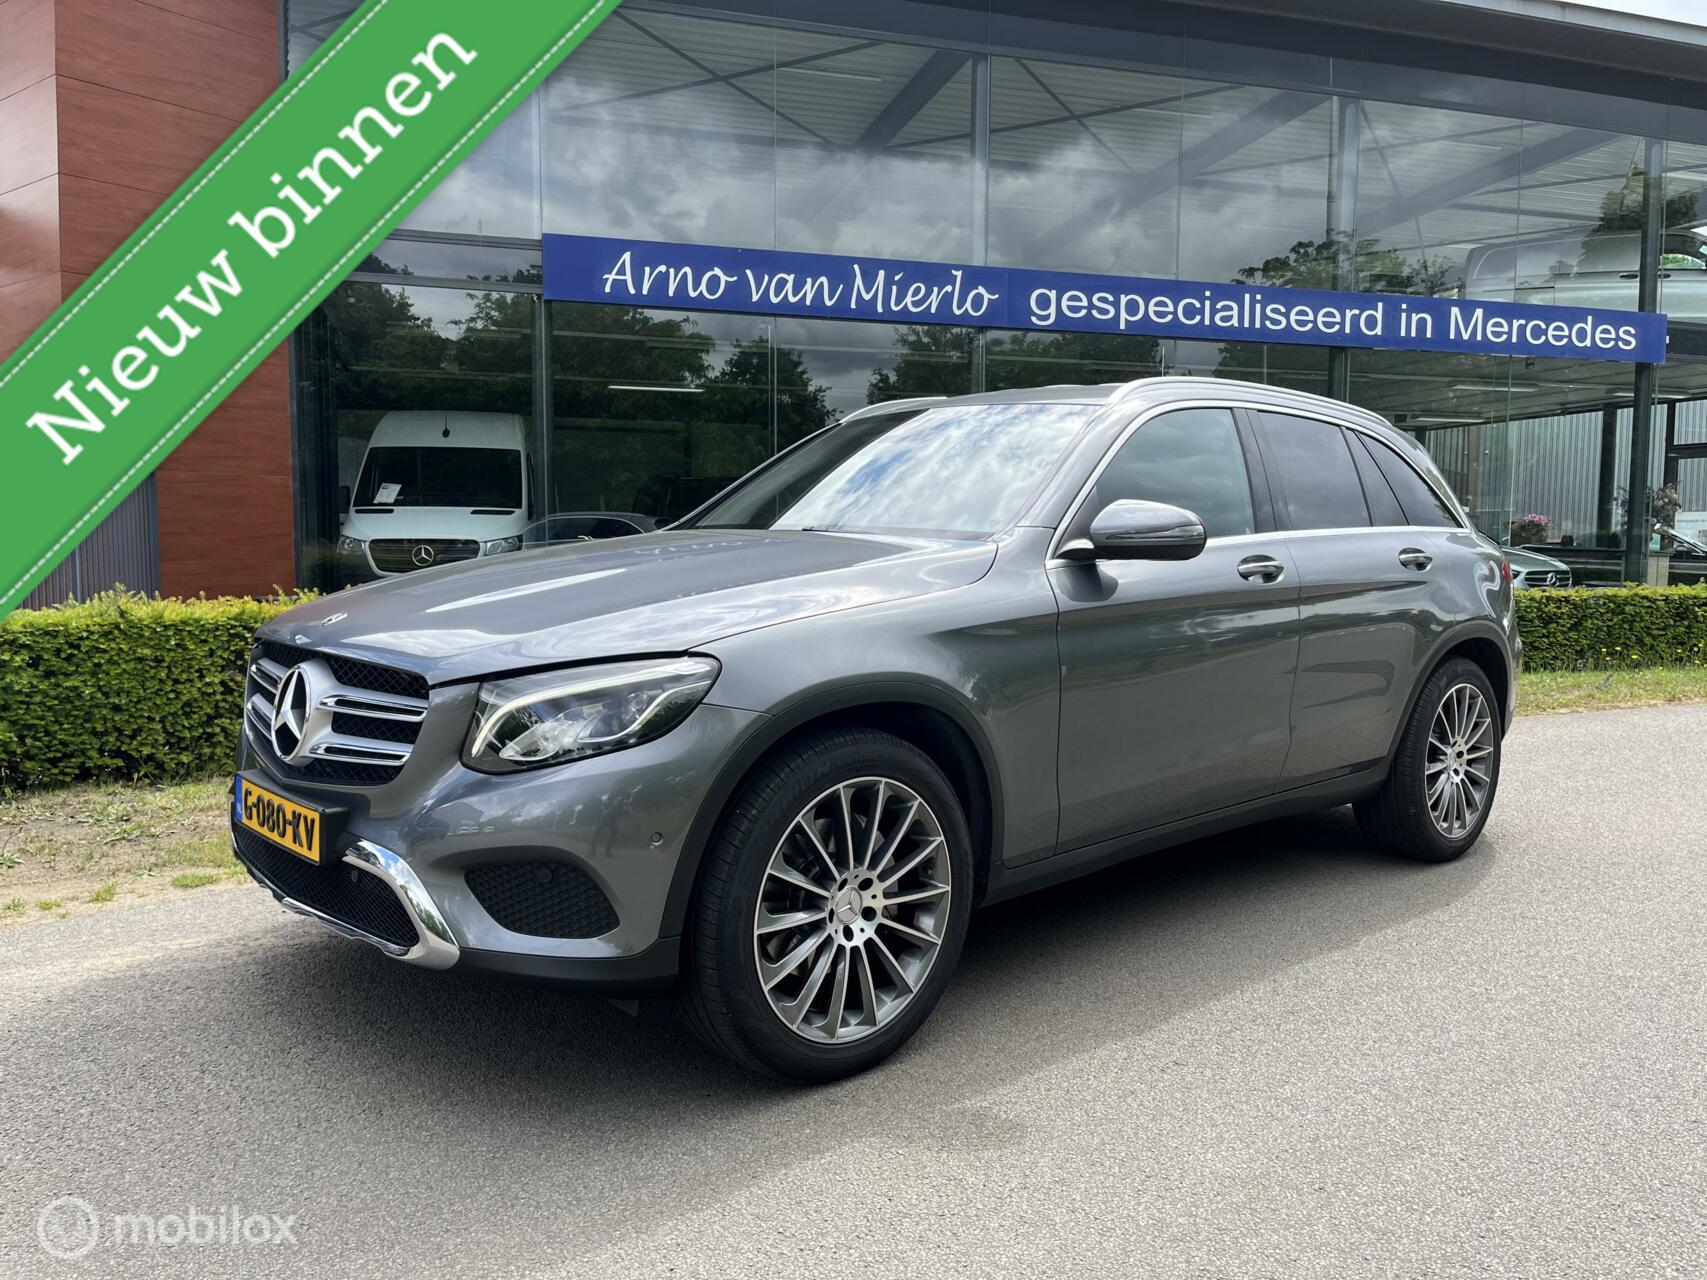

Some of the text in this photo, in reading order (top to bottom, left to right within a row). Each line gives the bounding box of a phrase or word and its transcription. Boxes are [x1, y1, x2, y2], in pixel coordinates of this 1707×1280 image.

[602, 251, 1638, 350] Arno van Mierlo gespecialiseerd in Mercedes
[244, 787, 316, 852] G-080-KV
